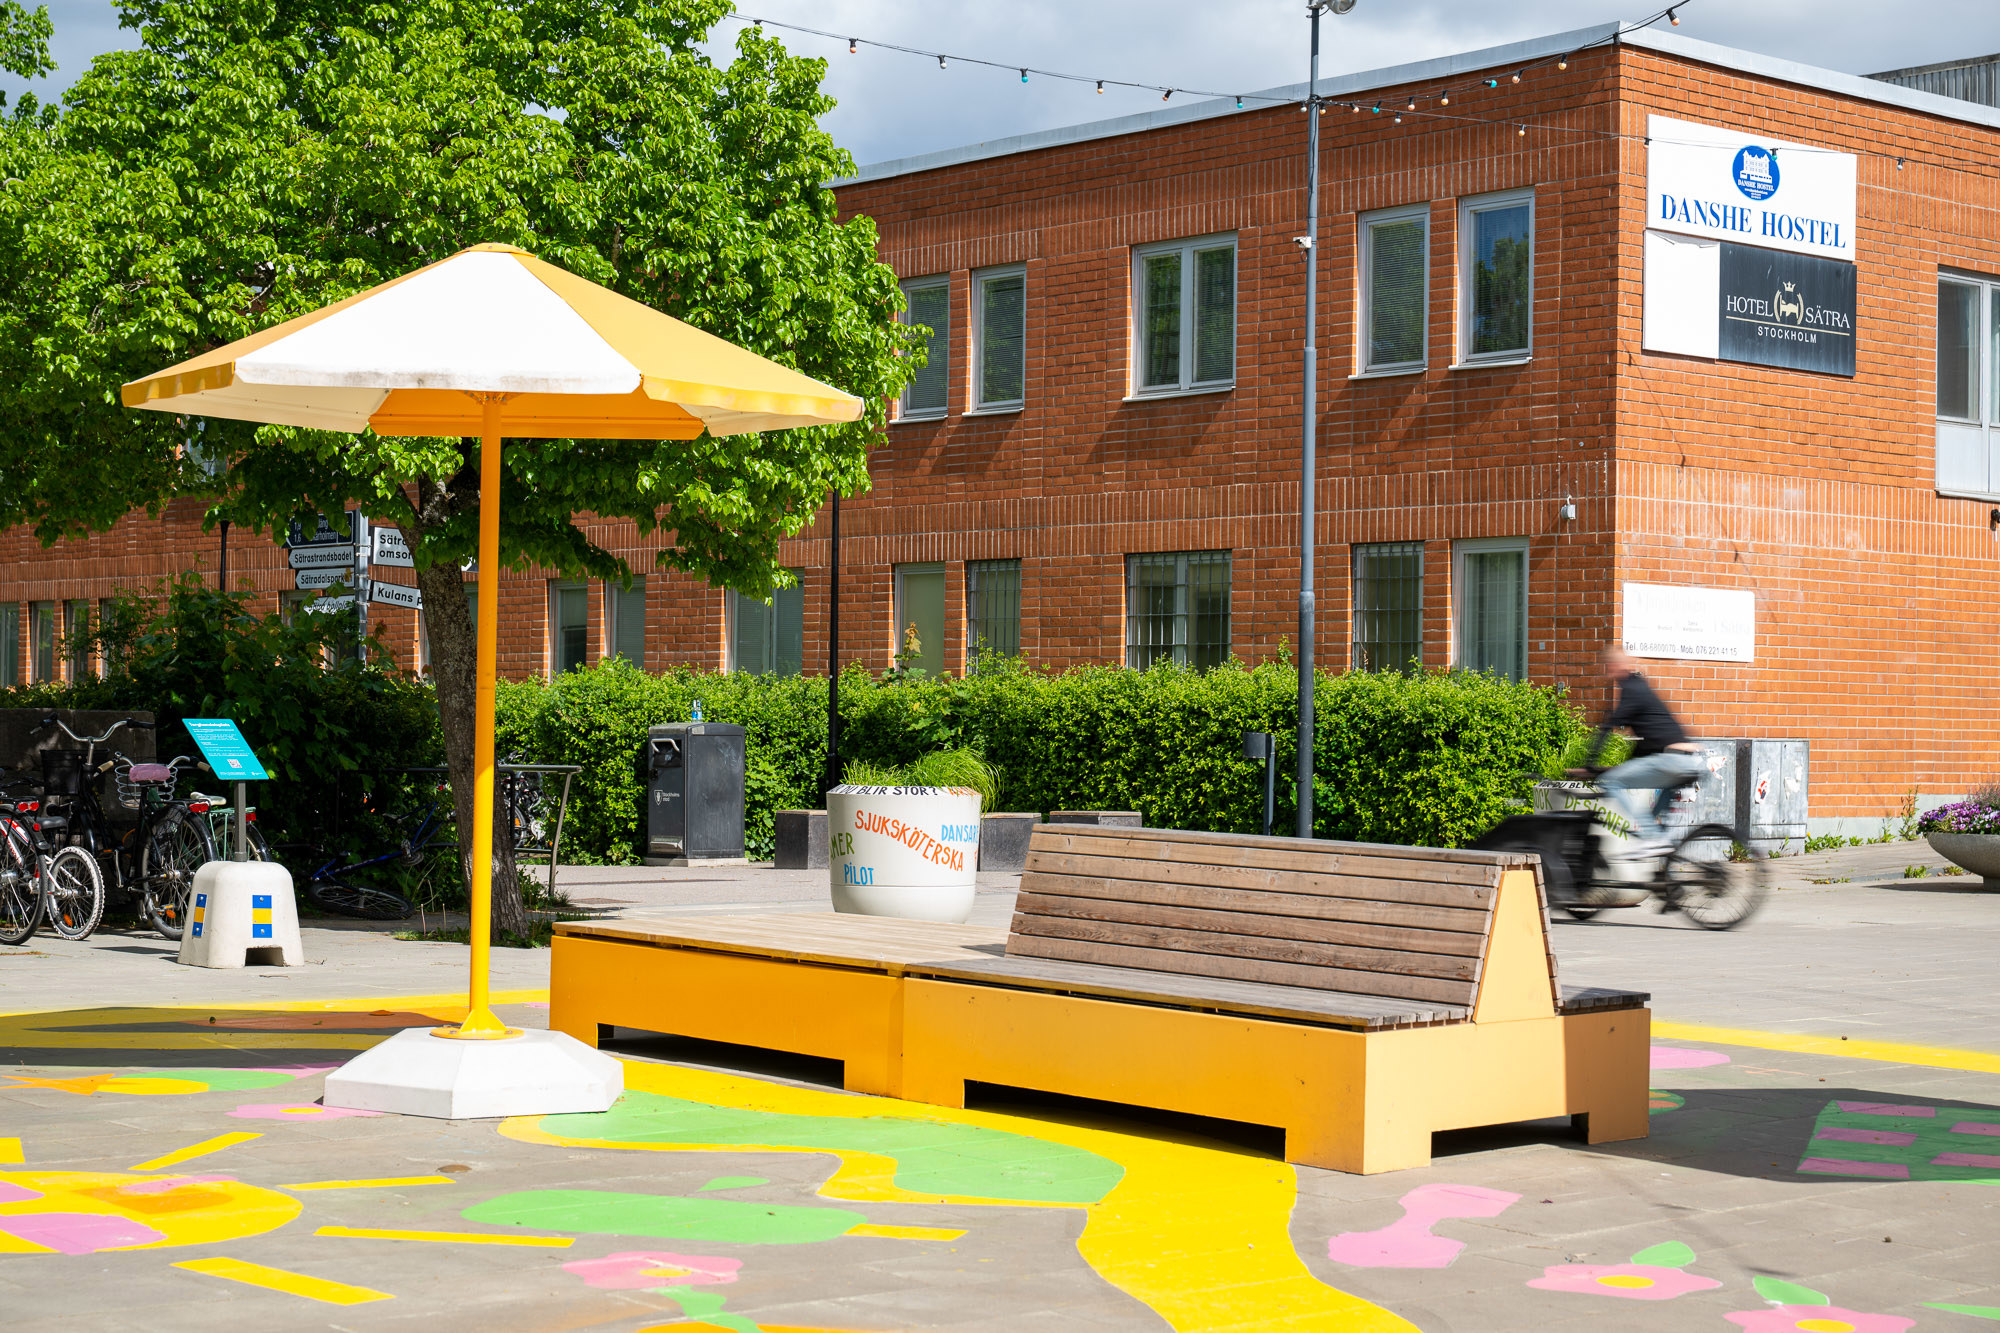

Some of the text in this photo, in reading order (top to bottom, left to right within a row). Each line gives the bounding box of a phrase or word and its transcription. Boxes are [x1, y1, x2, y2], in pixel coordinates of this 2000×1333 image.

[1661, 194, 1846, 248] DANSHE HOSTEL
[1727, 295, 1850, 328] HOTEL SÄTRA
[1757, 326, 1817, 343] STOCKHOLM
[294, 551, 352, 563] Sätrastrandsbadet
[377, 587, 414, 603] Kulans
[856, 786, 888, 795] BLIR
[893, 786, 938, 796] STOR?
[855, 810, 963, 872] SJUKSKÖTERSKA
